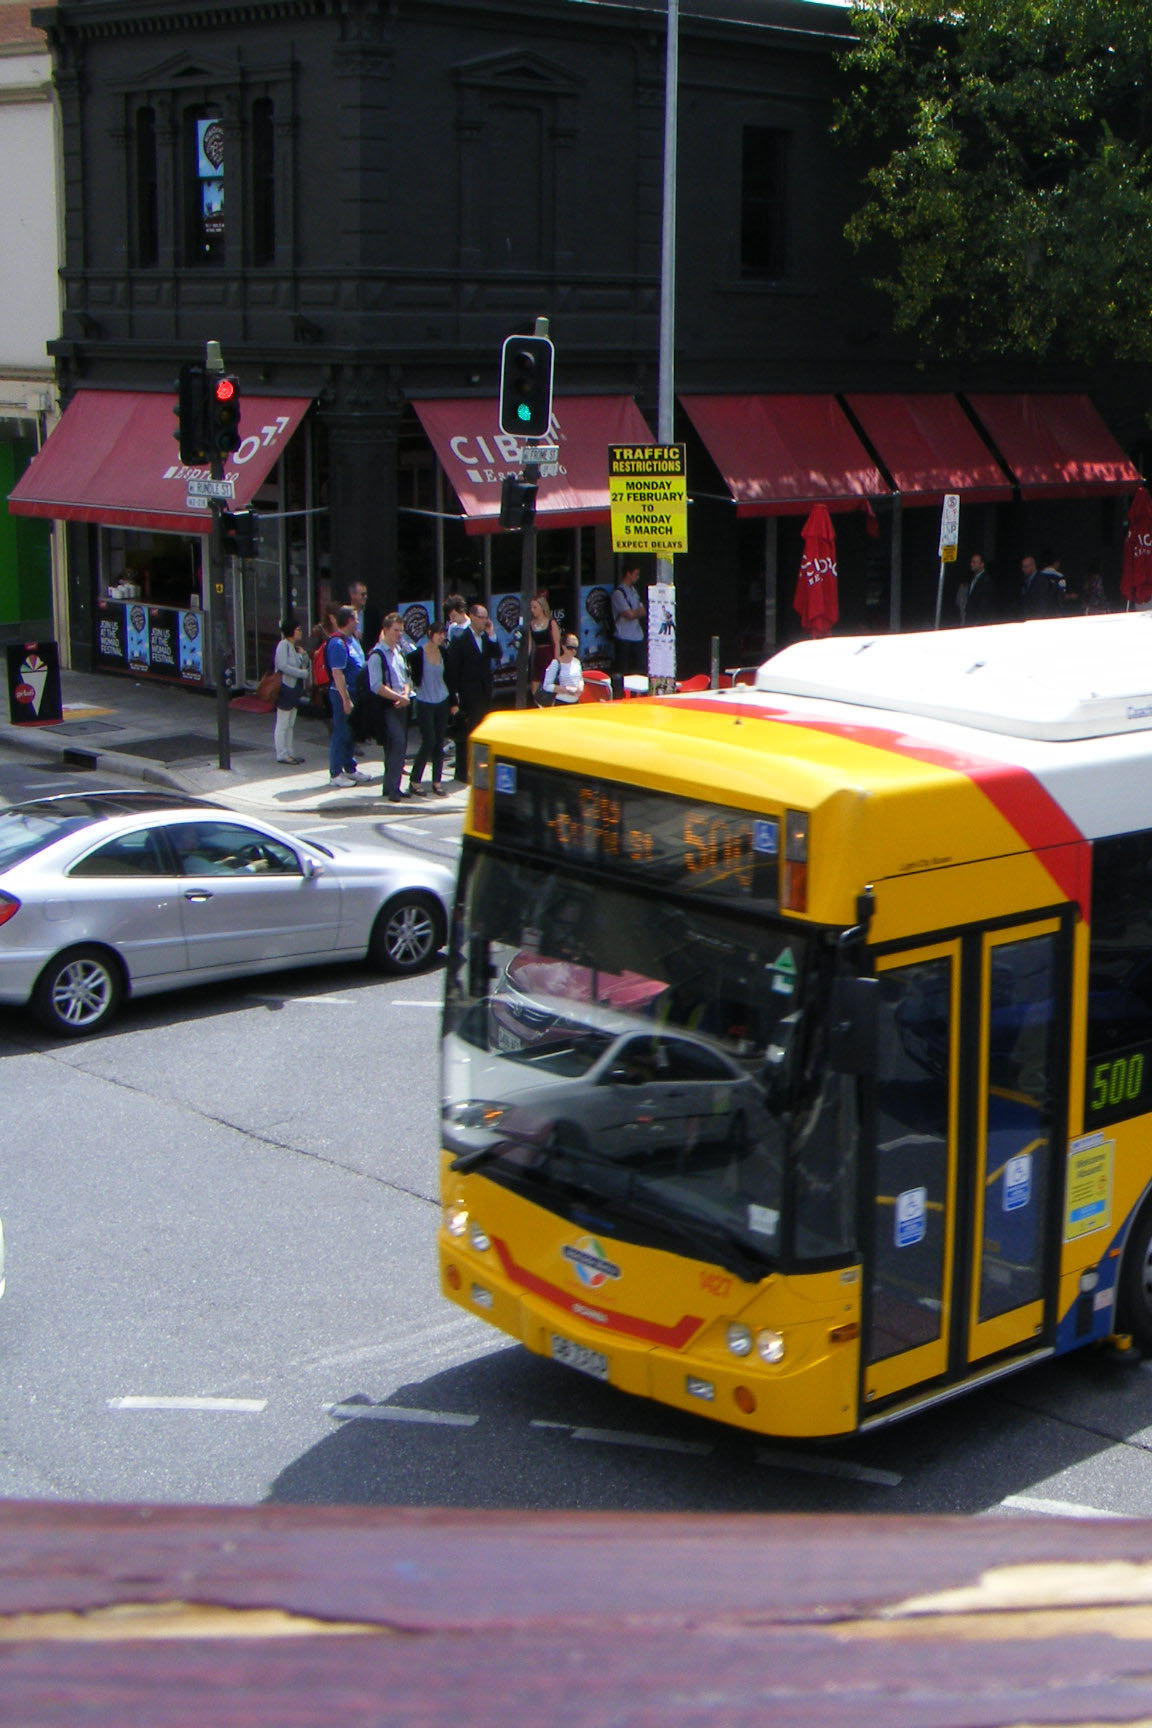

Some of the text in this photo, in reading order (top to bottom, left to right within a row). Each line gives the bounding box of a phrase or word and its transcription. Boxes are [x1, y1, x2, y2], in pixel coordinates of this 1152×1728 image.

[613, 448, 680, 460] TRAFFIC
[612, 460, 681, 472] RESTRICTIONS
[625, 481, 672, 491] MONDAY
[611, 492, 684, 502] 27 FEBRUARY
[641, 504, 654, 512] TO
[625, 514, 672, 524] MONDAY
[625, 526, 673, 535] 5 MARCH
[616, 541, 683, 549] EXPECT DELAYS
[1090, 1053, 1145, 1111] 500
